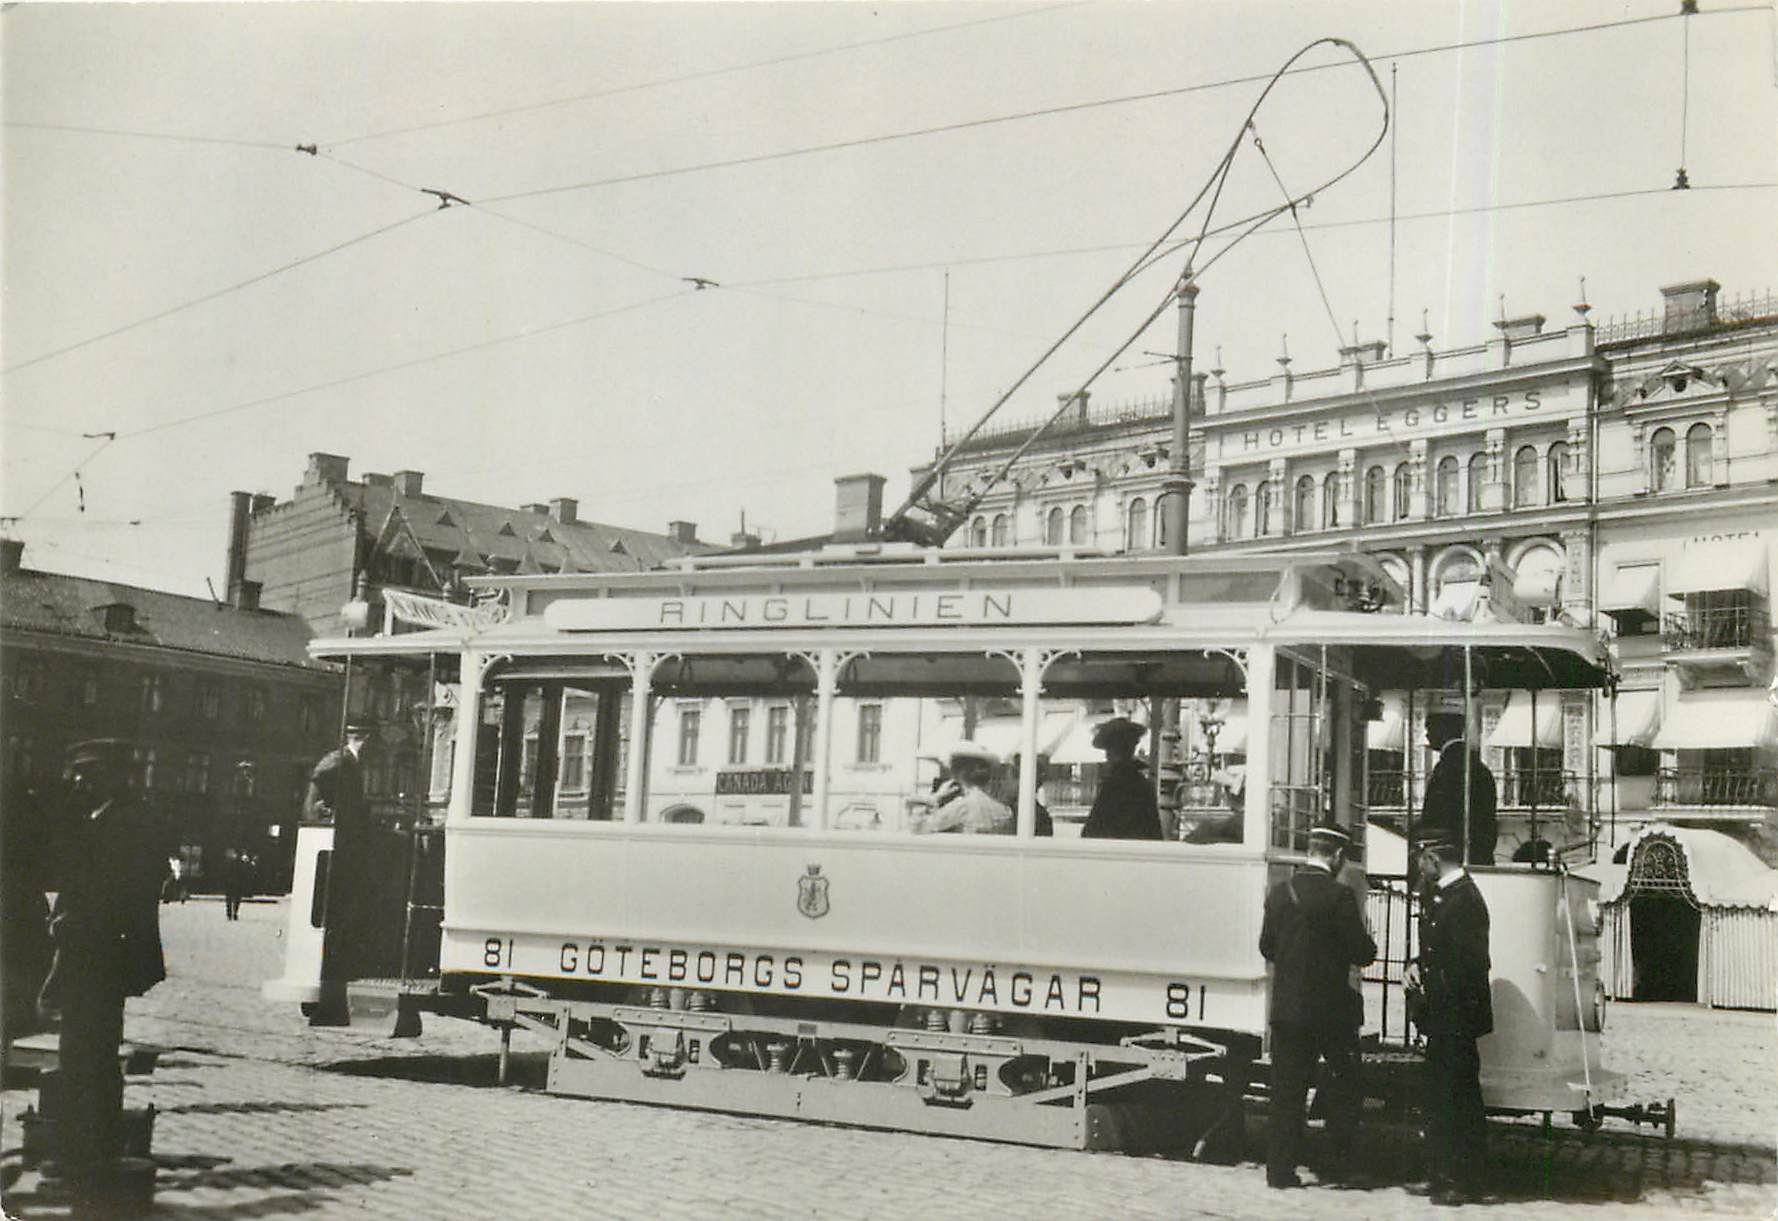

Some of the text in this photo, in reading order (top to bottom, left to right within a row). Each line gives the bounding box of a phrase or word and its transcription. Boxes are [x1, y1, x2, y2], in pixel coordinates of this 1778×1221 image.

[1243, 391, 1542, 450] HOTEL EGGERS
[660, 594, 1012, 623] RINGLINIEN
[718, 773, 769, 791] CANADA
[484, 938, 1206, 1021] 81 GÖTEBORGS SPÅRVÄGAR 81
